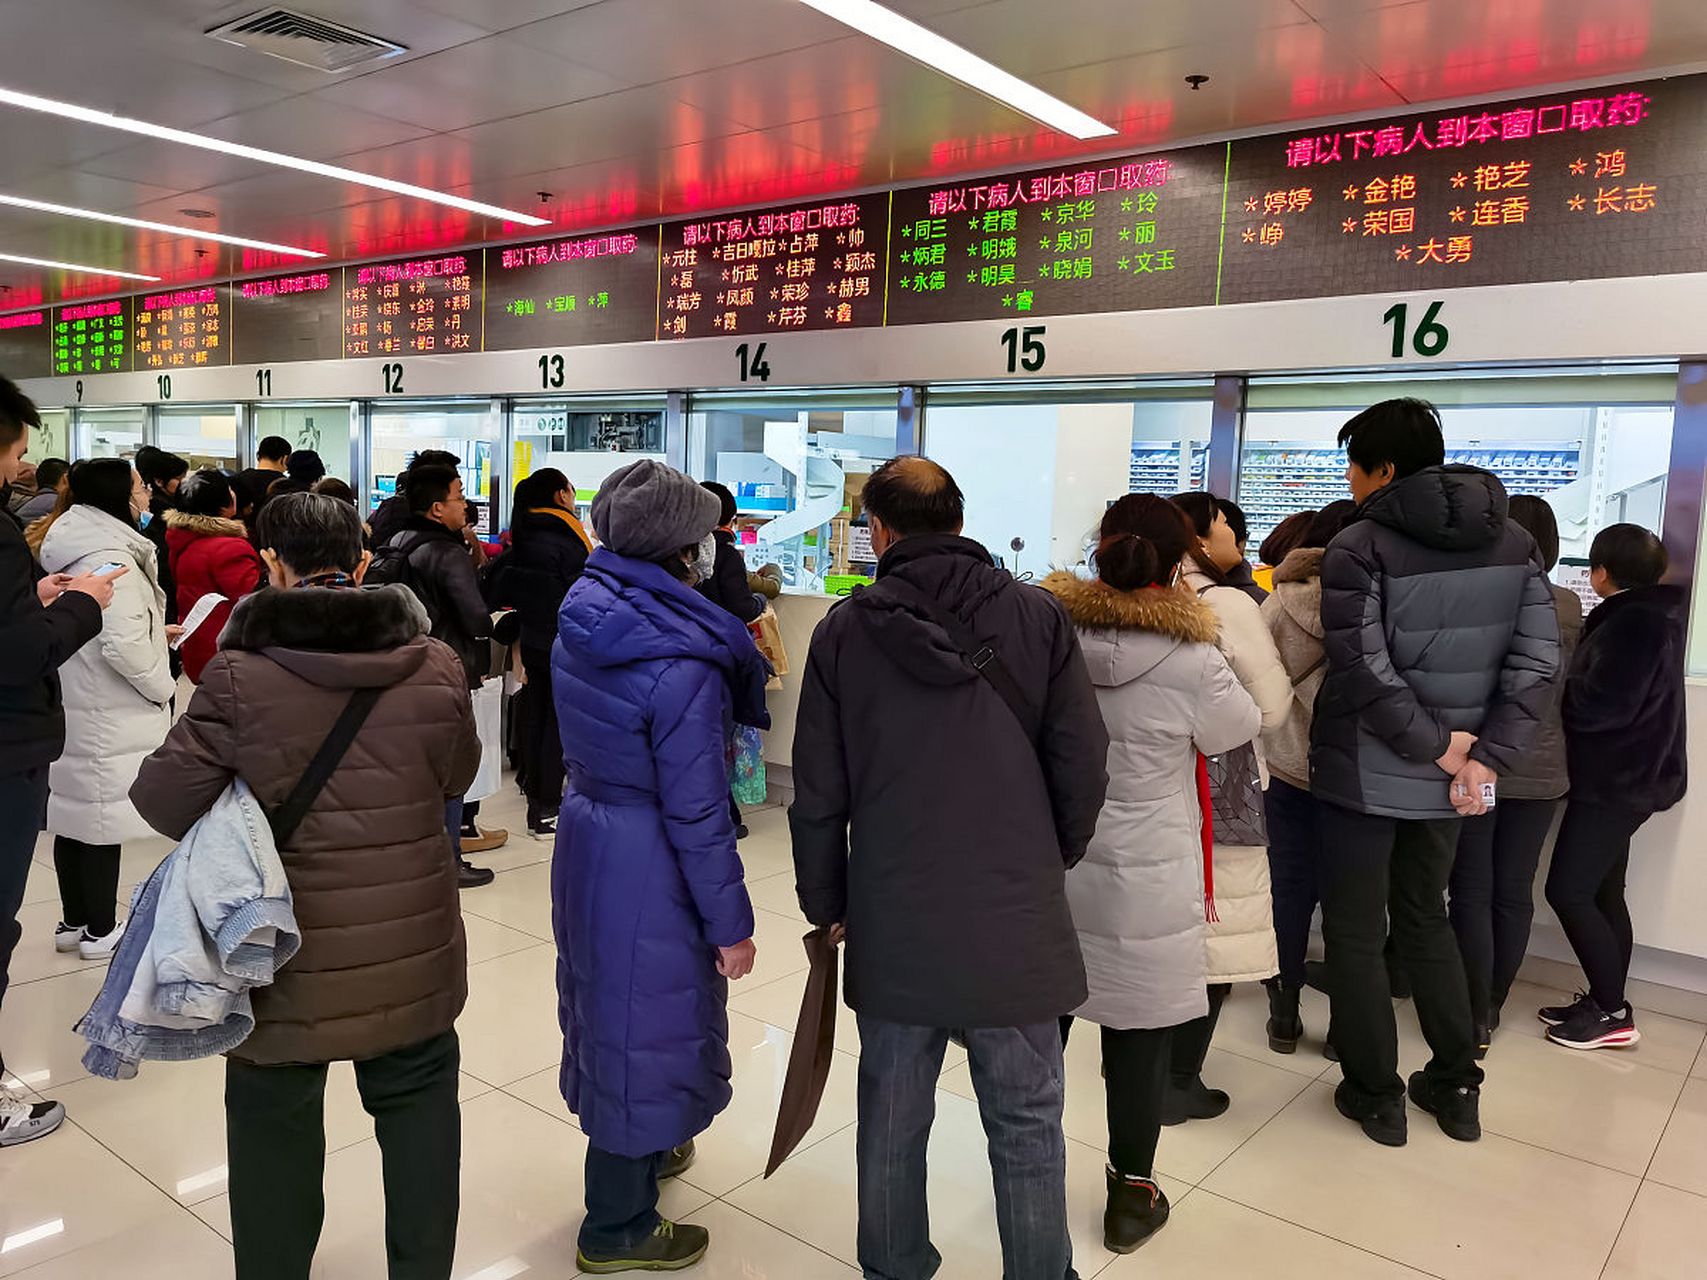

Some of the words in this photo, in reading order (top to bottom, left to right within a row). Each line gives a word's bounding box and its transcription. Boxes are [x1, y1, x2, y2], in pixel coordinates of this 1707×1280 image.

[1384, 302, 1448, 357] 16
[736, 343, 770, 381] 14
[1002, 326, 1045, 372] 15
[256, 370, 270, 396] 11
[383, 364, 403, 393] 12
[539, 355, 564, 388] 13
[77, 381, 82, 402] 9
[158, 376, 170, 399] 10
